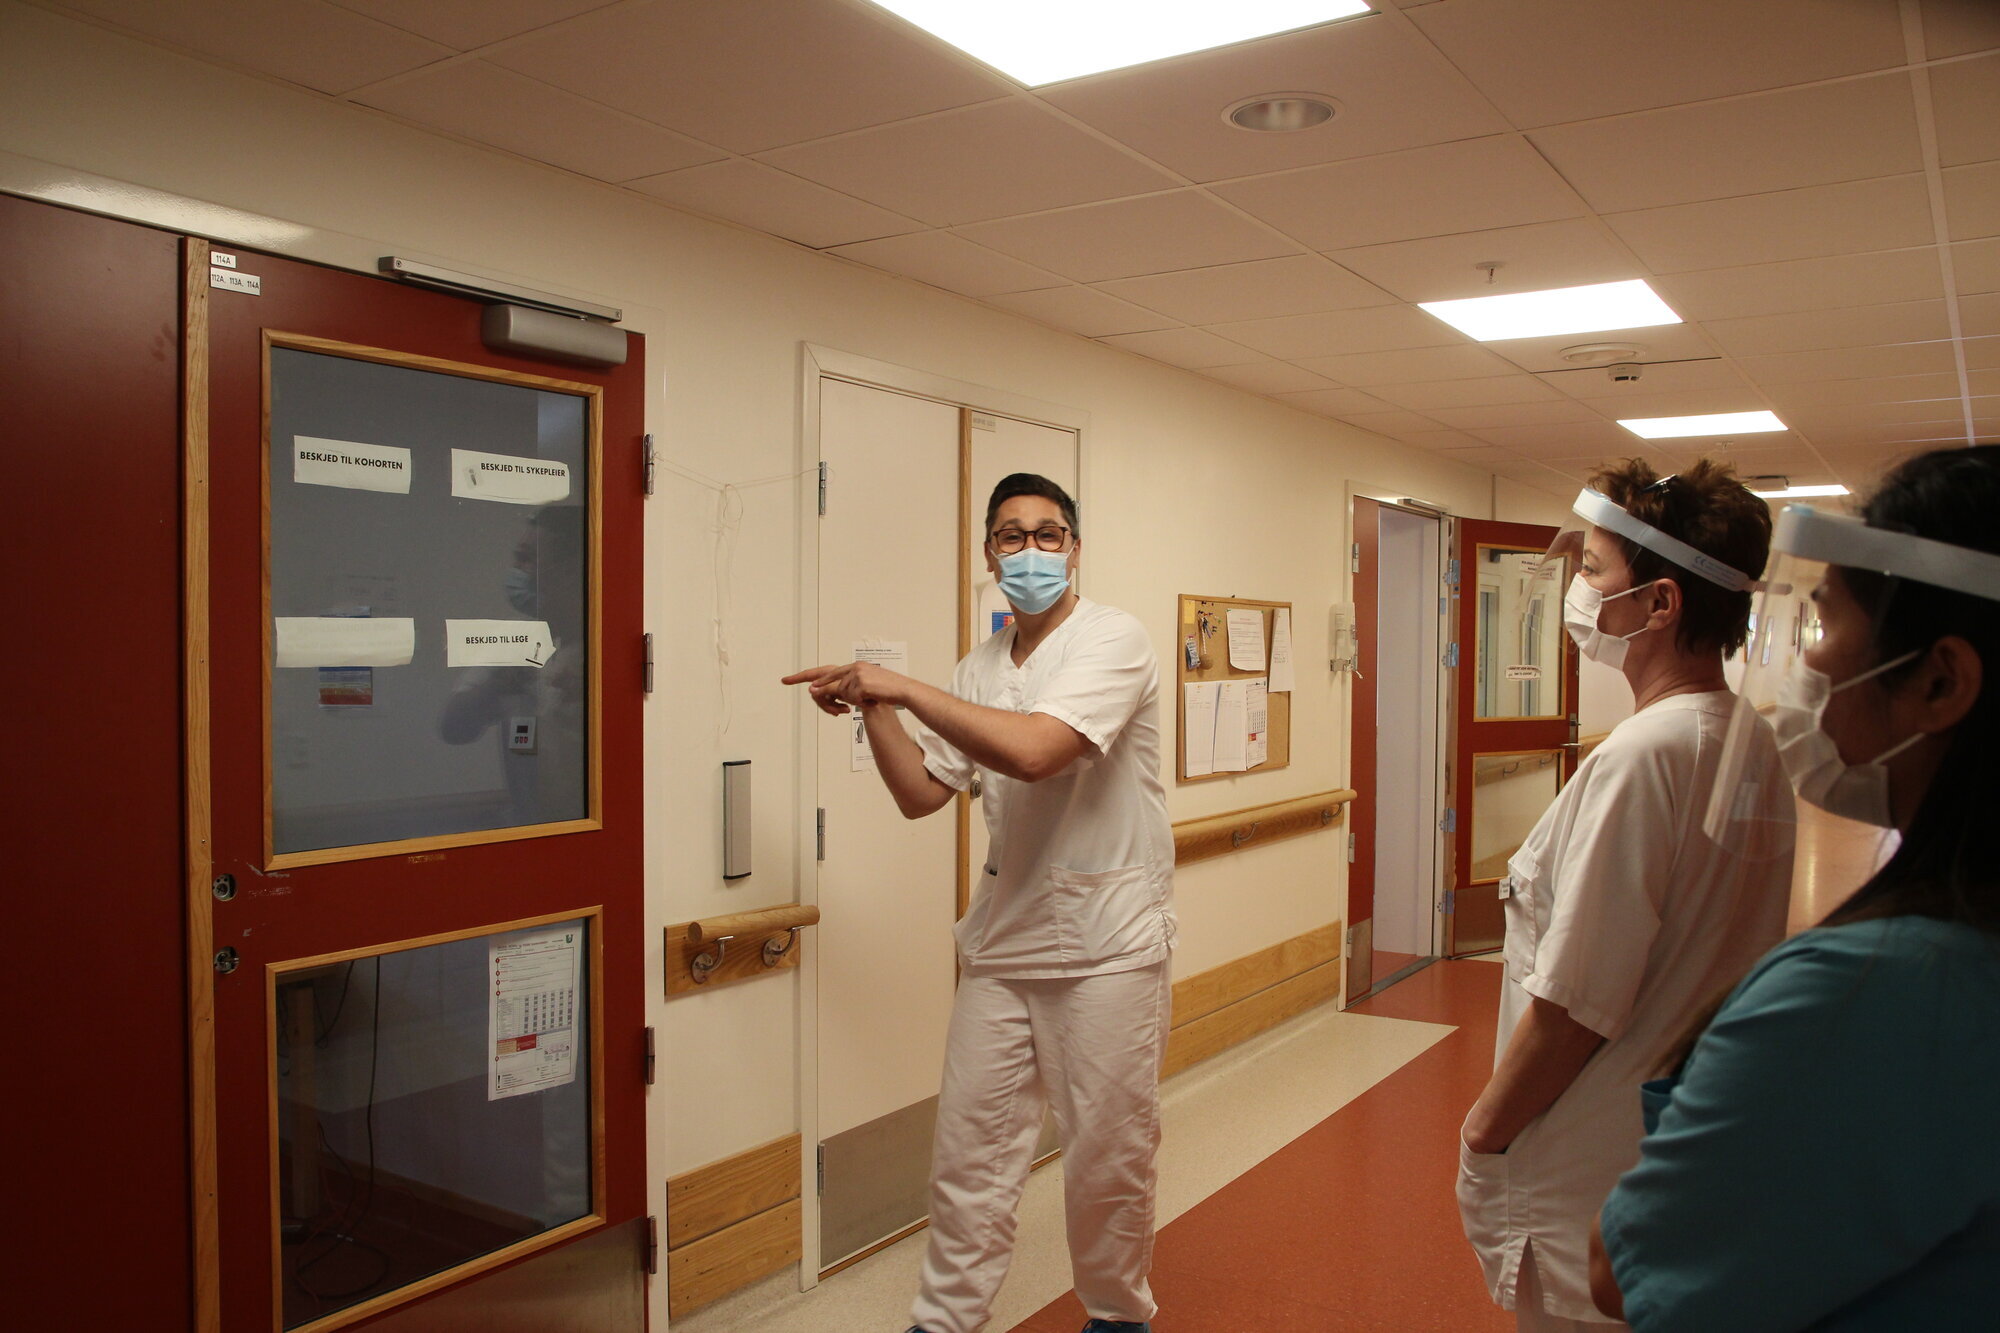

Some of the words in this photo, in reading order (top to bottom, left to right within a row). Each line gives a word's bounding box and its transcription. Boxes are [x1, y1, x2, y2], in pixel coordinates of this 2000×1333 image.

[216, 255, 231, 264] 114A
[247, 280, 259, 289] 114A
[300, 451, 338, 463] BESKJED
[341, 455, 352, 465] TIL
[354, 457, 403, 470] KOHORTEN
[480, 462, 513, 473] BESKJED
[515, 465, 524, 473] TIL
[526, 466, 566, 477] SYKEPLEIER
[465, 636, 498, 644] BESKJED
[511, 635, 529, 643] LEGE
